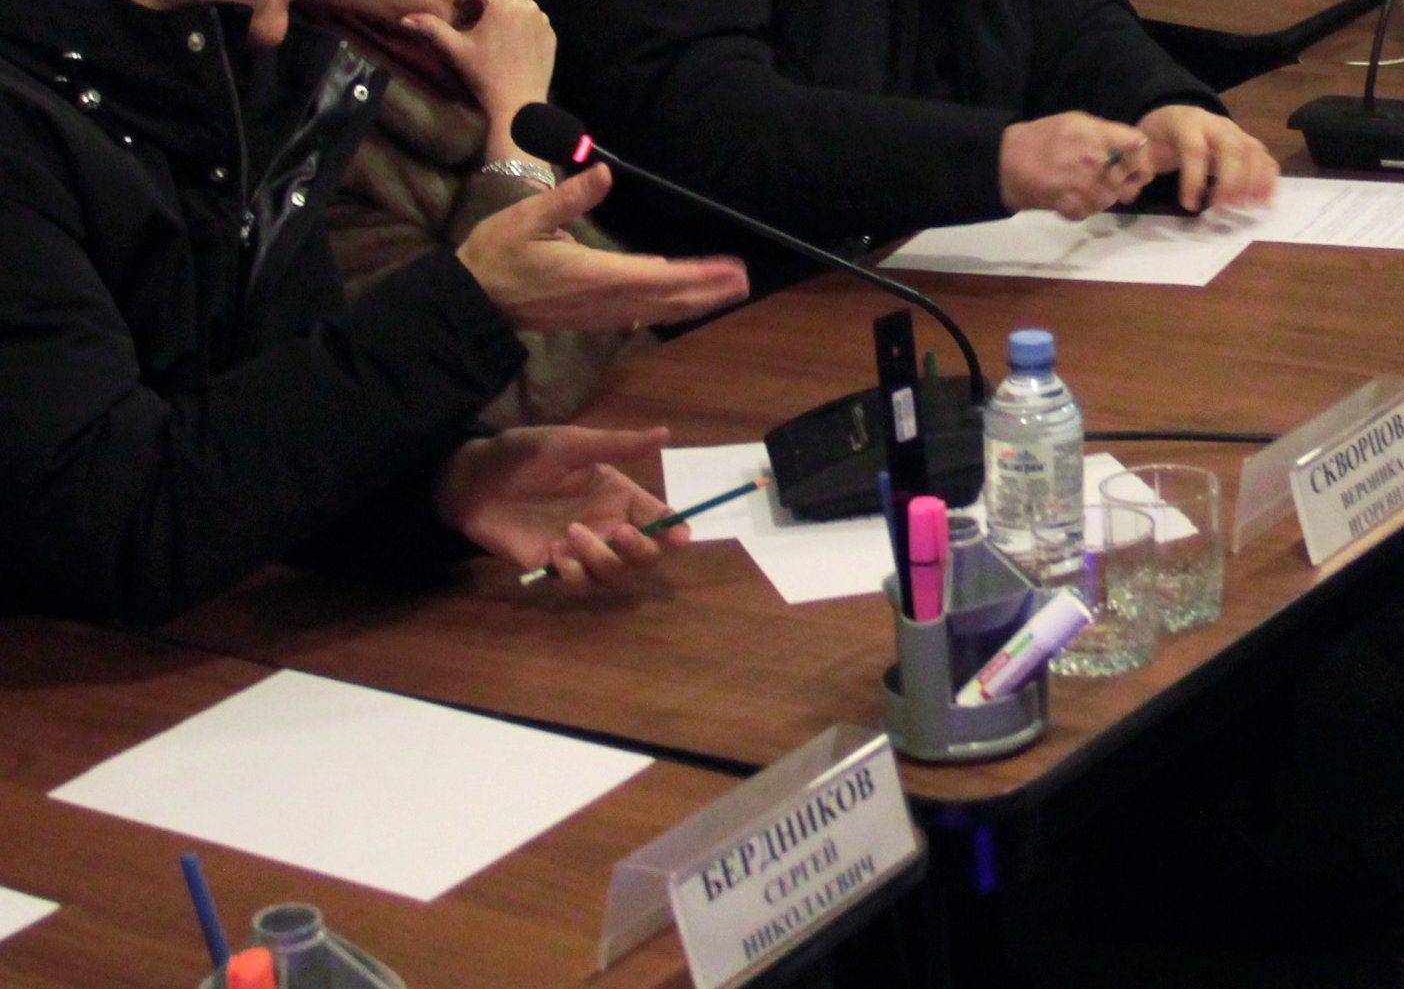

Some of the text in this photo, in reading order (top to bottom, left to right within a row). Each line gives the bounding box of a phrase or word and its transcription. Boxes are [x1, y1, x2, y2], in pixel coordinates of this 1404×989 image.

[1340, 458, 1404, 510] ВЕРОНИКА
[700, 767, 876, 903] БЕРДНИКОВ
[763, 837, 839, 905] СЕРГЕЙ
[741, 855, 876, 960] НИКОЛАЕВИЧ
